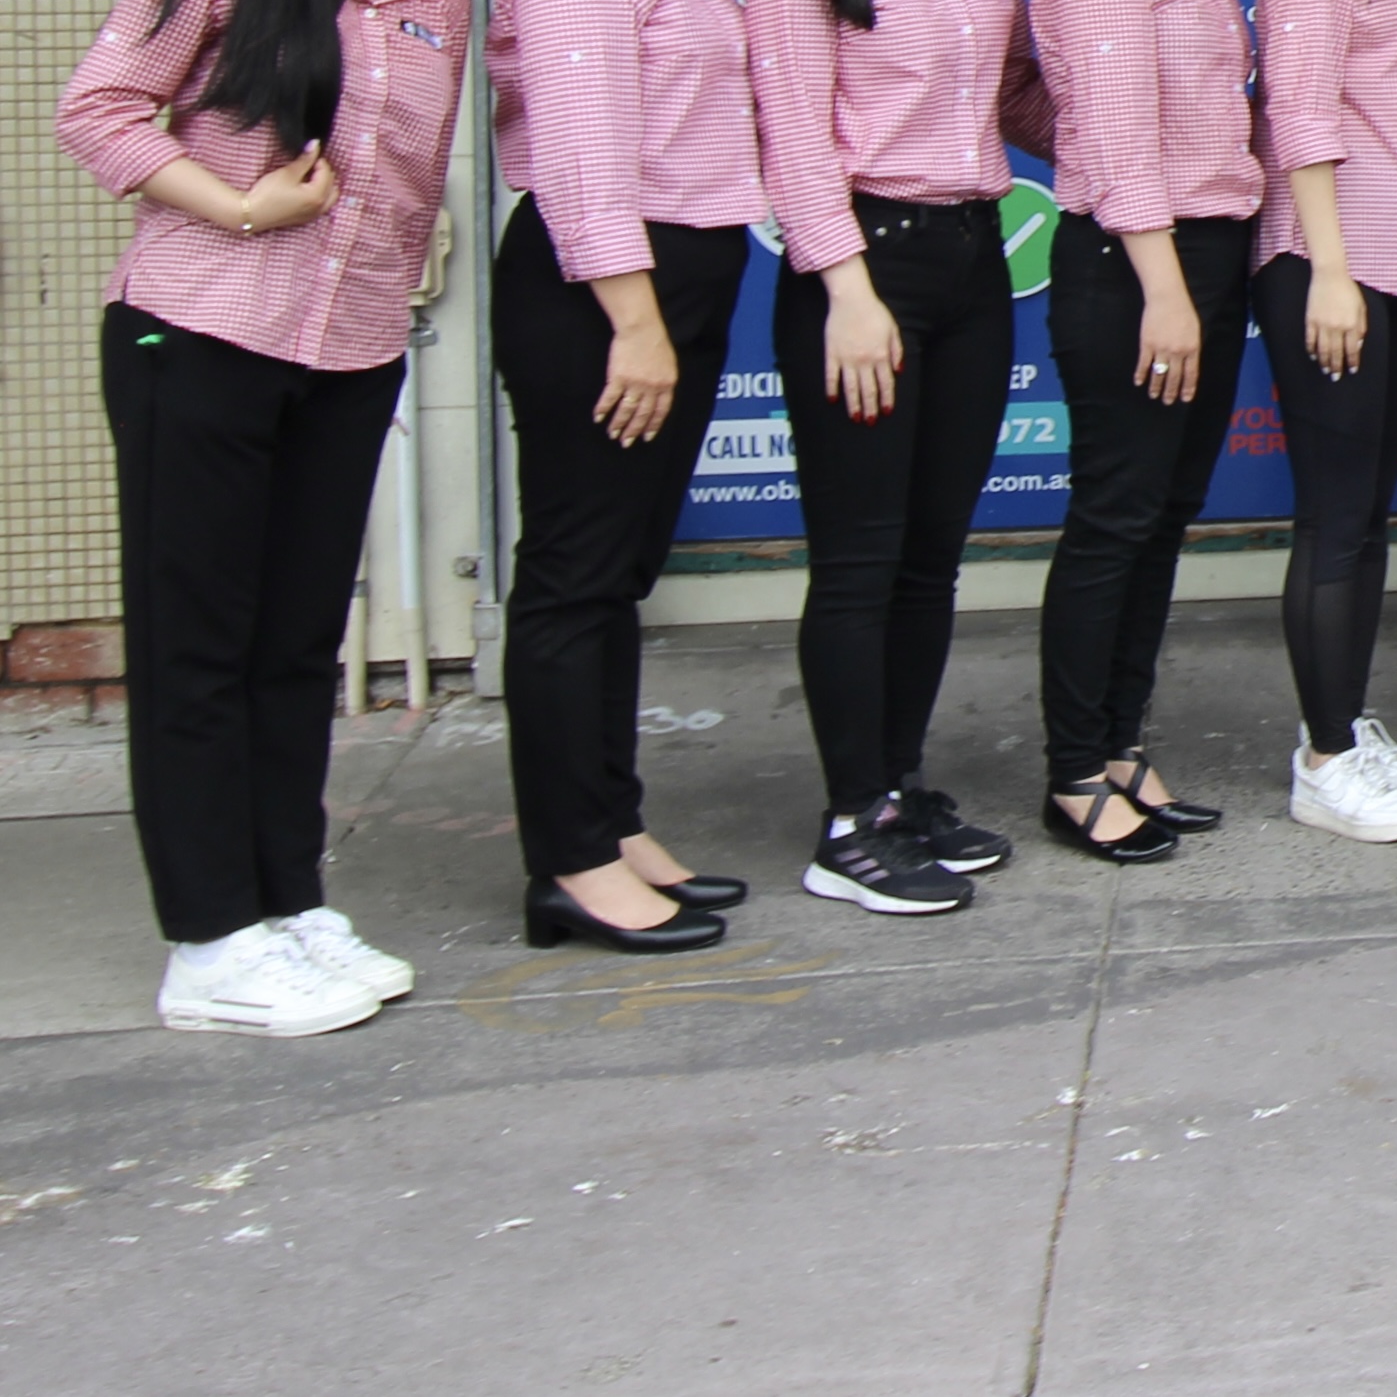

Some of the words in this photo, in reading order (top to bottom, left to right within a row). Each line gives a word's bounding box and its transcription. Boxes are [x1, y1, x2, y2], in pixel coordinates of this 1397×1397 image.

[1230, 407, 1284, 430] YOU
[706, 434, 762, 460] CALL
[769, 433, 798, 459] NO
[688, 478, 802, 504] www.ob
